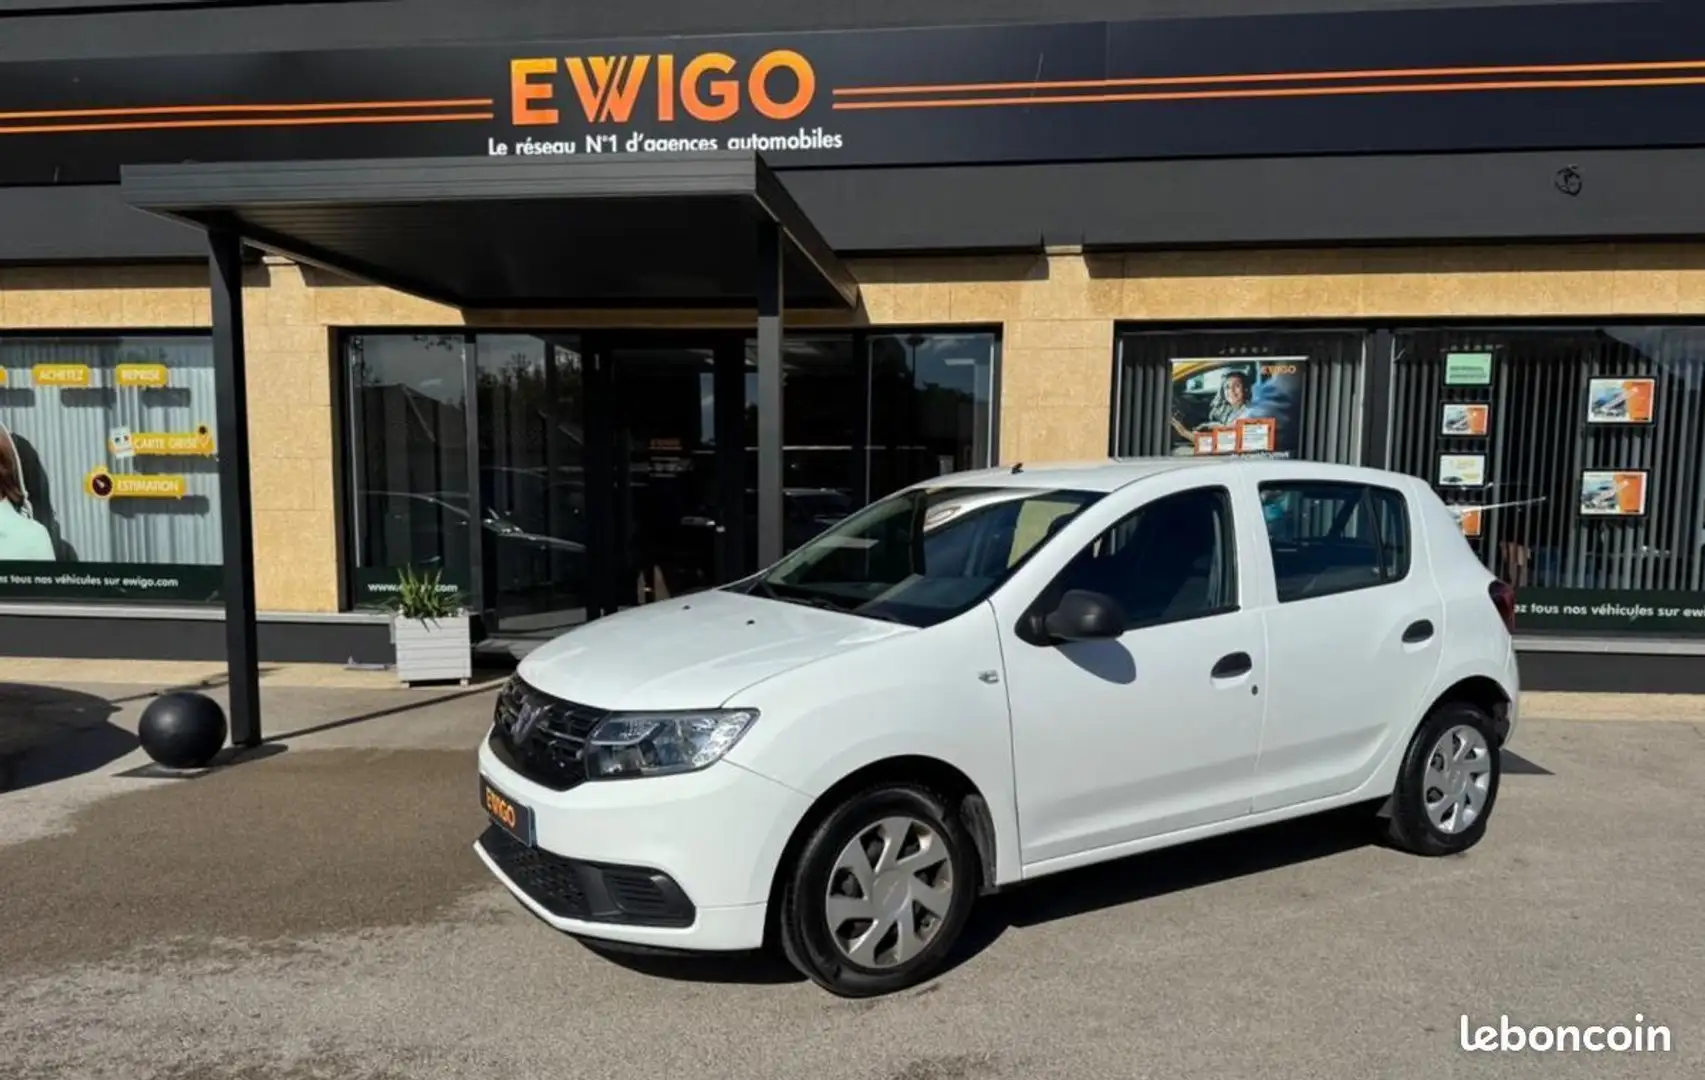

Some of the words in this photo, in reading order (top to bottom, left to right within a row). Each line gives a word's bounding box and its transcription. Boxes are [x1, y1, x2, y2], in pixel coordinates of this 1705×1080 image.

[510, 49, 816, 126] EWIGO
[488, 137, 508, 156] Le
[515, 137, 576, 155] réseau
[727, 126, 843, 151] automobiles
[38, 368, 84, 381] ACHETEZ
[134, 437, 165, 449] CARTE
[117, 479, 179, 492] ESTIMATION
[10, 574, 32, 585] tous
[34, 576, 53, 585] nos
[55, 573, 101, 586] véhicules
[103, 577, 120, 586] sur
[122, 575, 179, 589] ewigo.com
[1530, 602, 1560, 615] tous
[1563, 604, 1588, 615] nos
[1591, 603, 1654, 617] véhicules
[1656, 606, 1680, 617] sur
[485, 785, 516, 828] EWIGO
